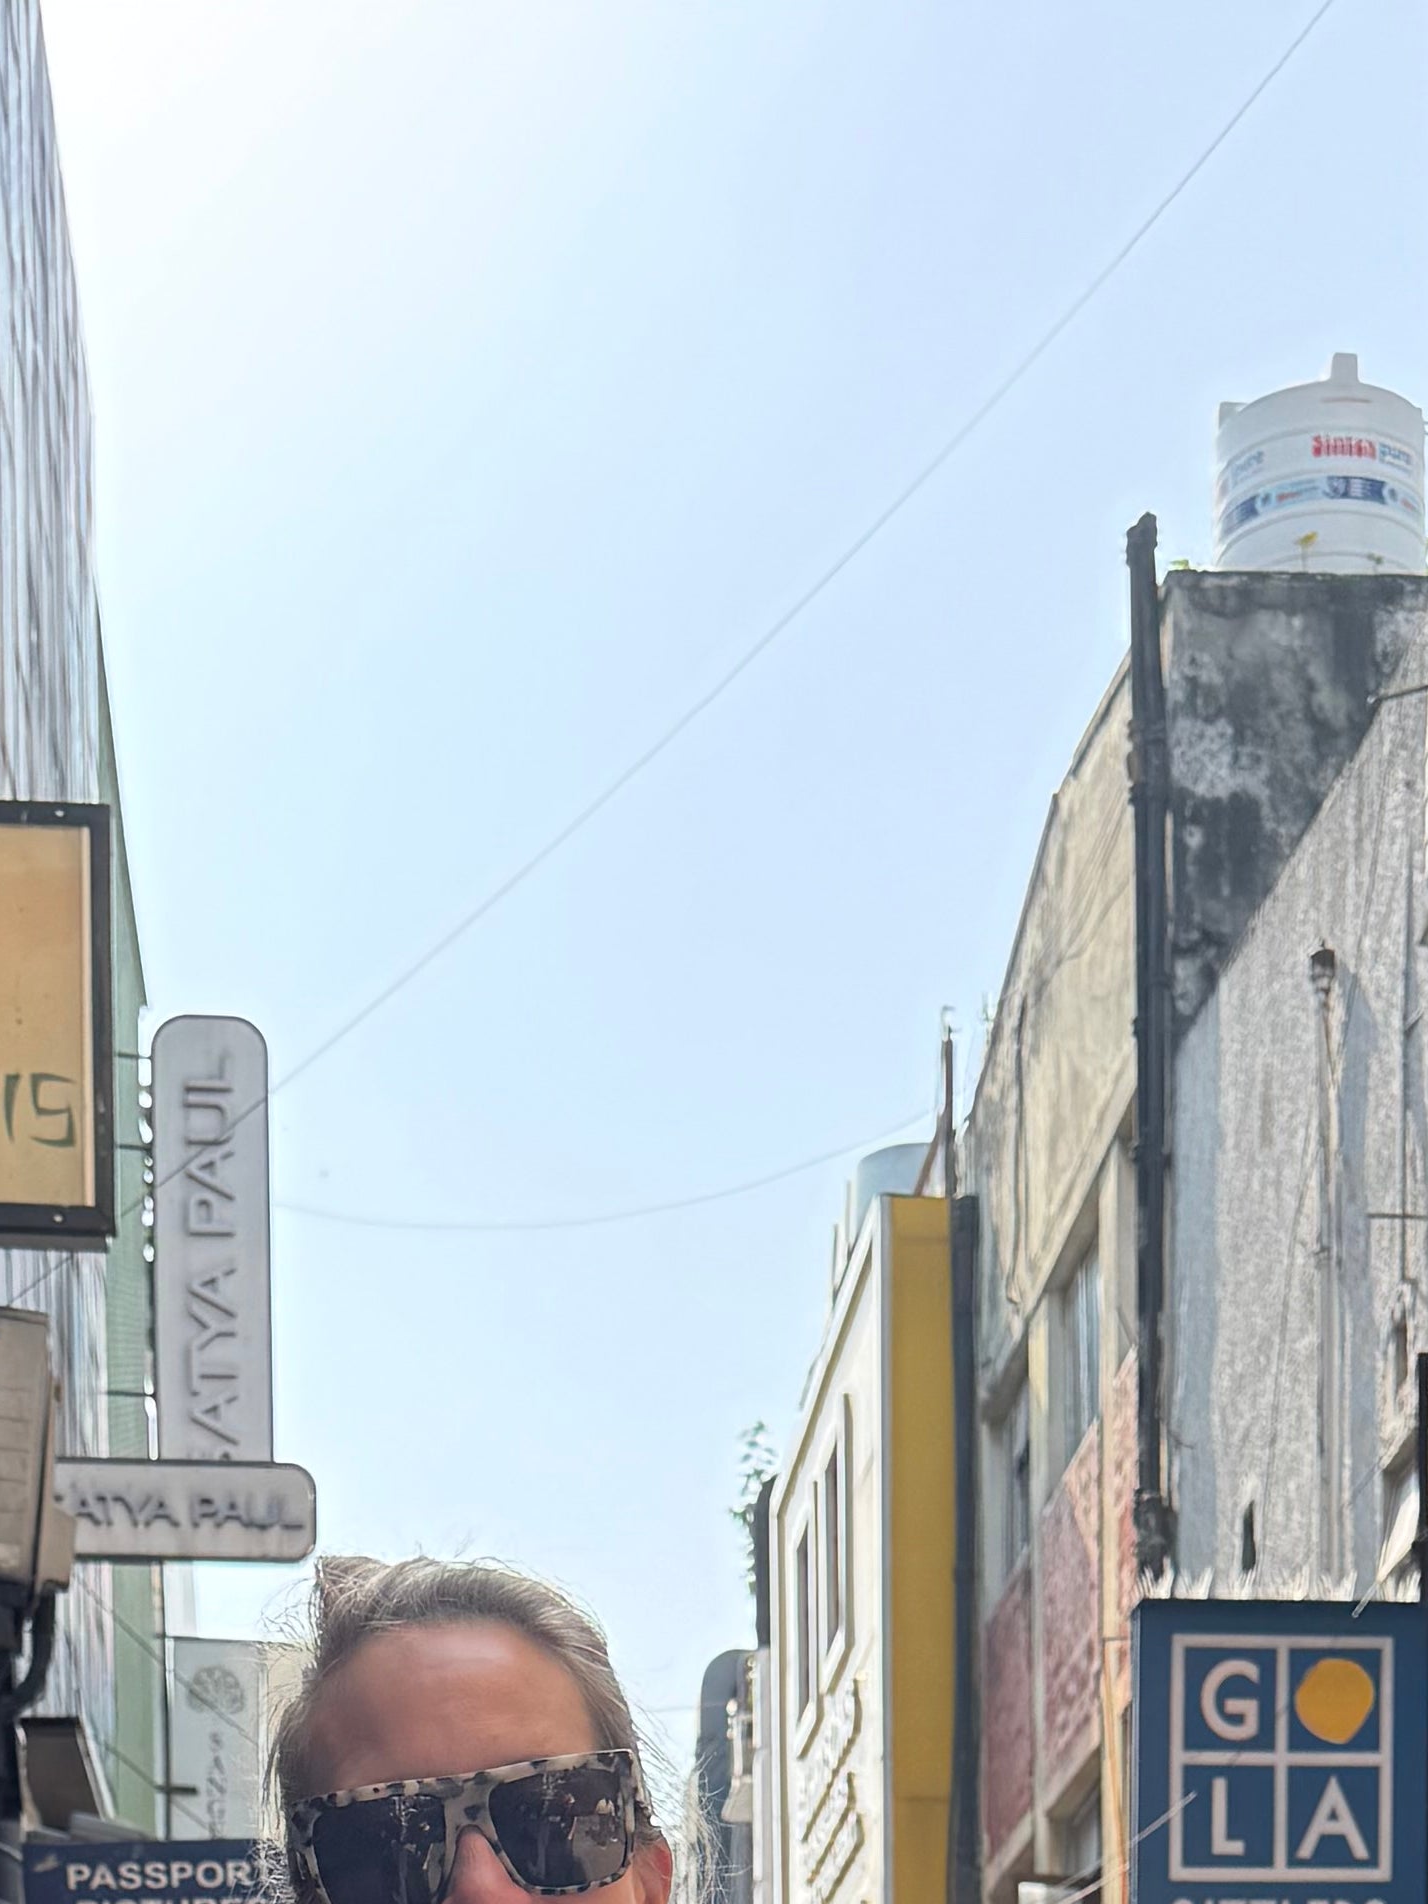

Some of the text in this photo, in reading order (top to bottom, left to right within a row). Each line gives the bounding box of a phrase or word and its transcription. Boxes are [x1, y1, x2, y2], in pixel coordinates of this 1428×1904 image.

[182, 1046, 236, 1239] PAUL
[54, 1490, 306, 1533] ATYA PAUL
[66, 1859, 258, 1890] PASSPOR
